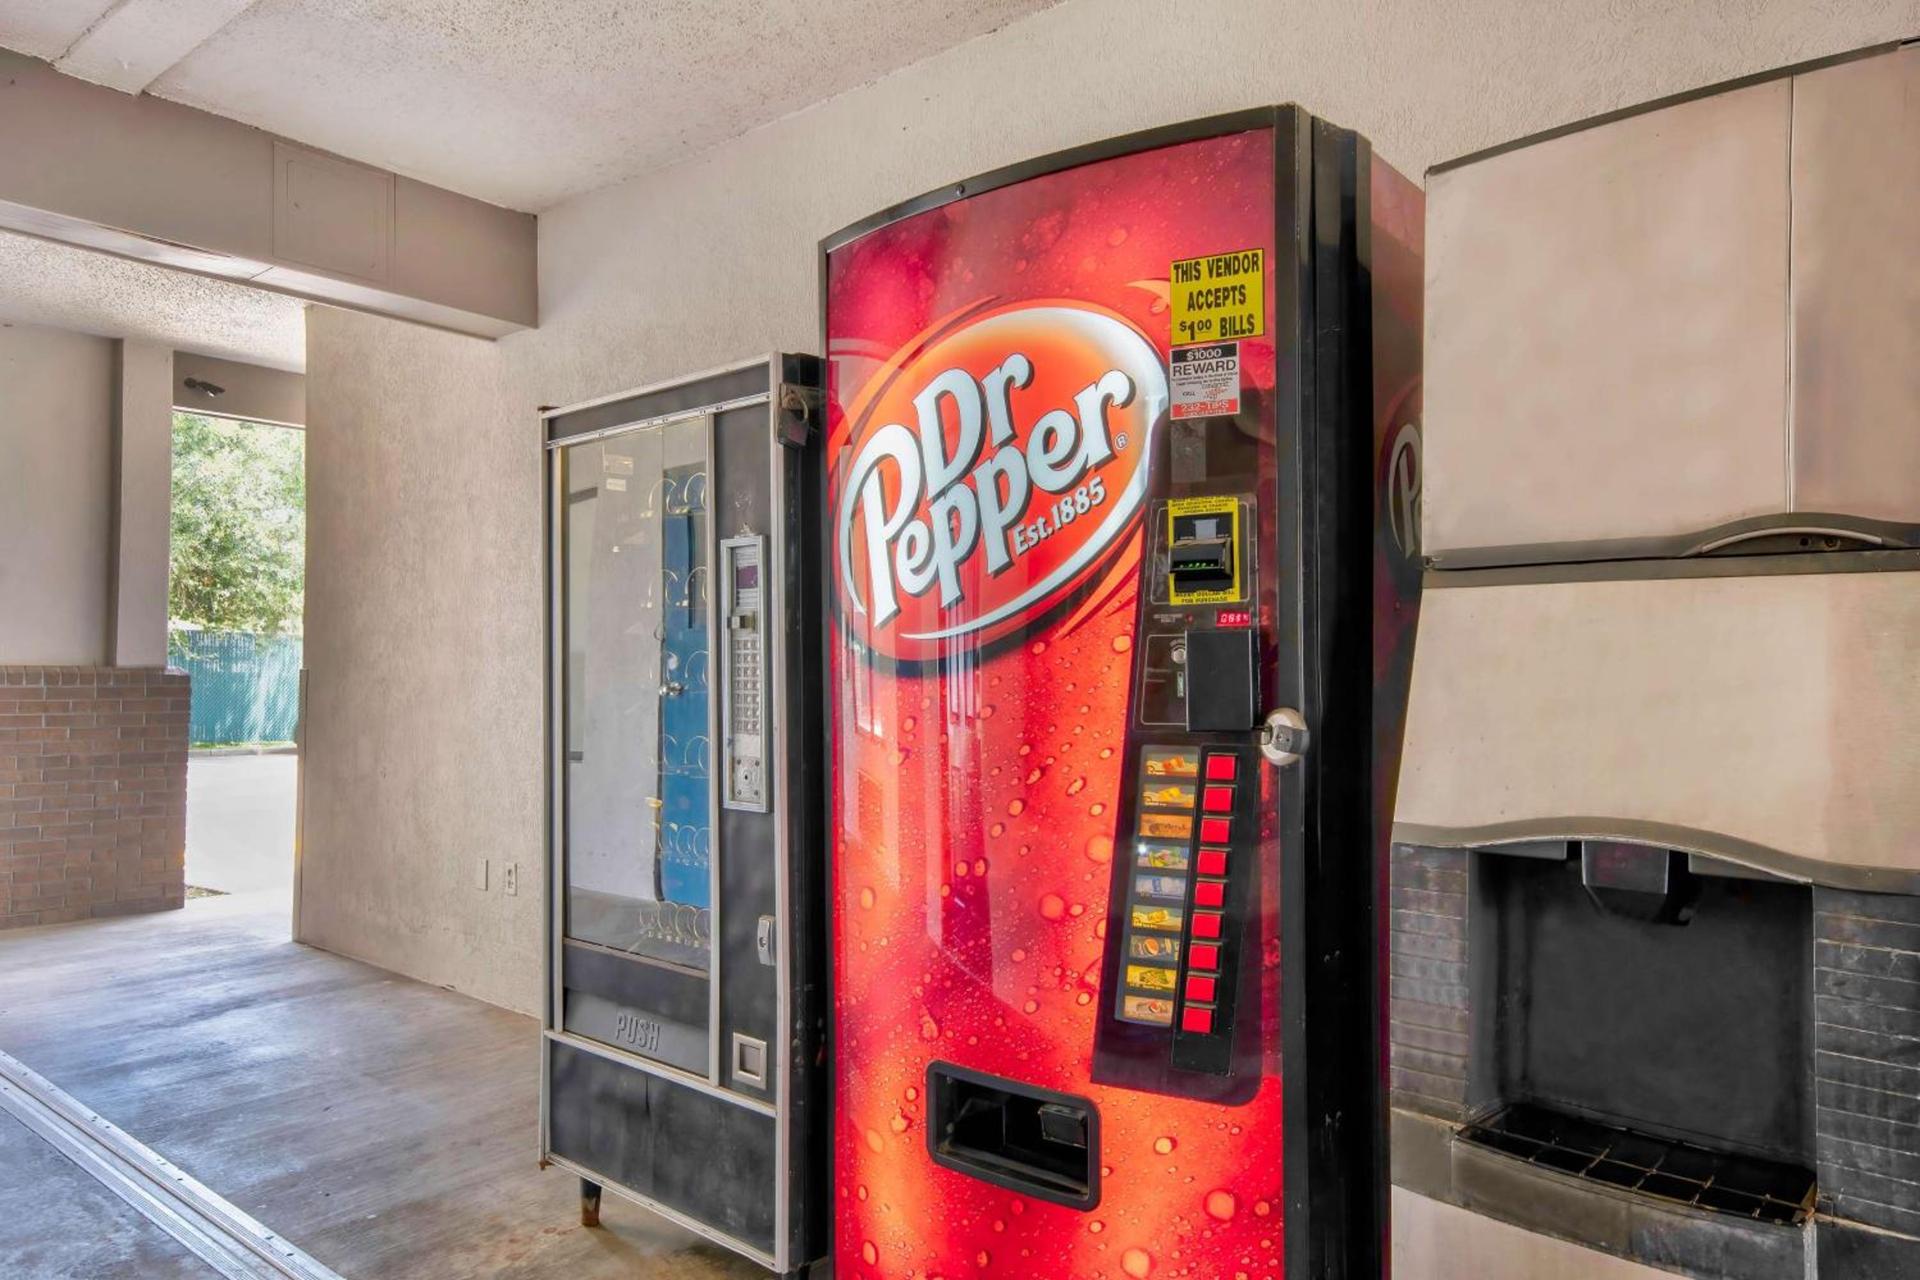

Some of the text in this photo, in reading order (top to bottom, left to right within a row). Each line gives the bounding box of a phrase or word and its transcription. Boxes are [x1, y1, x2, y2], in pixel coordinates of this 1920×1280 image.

[1174, 253, 1260, 284] THIS VENDOR
[1187, 284, 1247, 312] ACCEPTS
[1220, 313, 1255, 338] BILLS
[1173, 359, 1236, 376] REWARD
[1186, 348, 1222, 361] $1000
[913, 352, 1034, 500] Dr
[840, 369, 1135, 628] Pepper
[616, 1012, 661, 1052] PUSH
